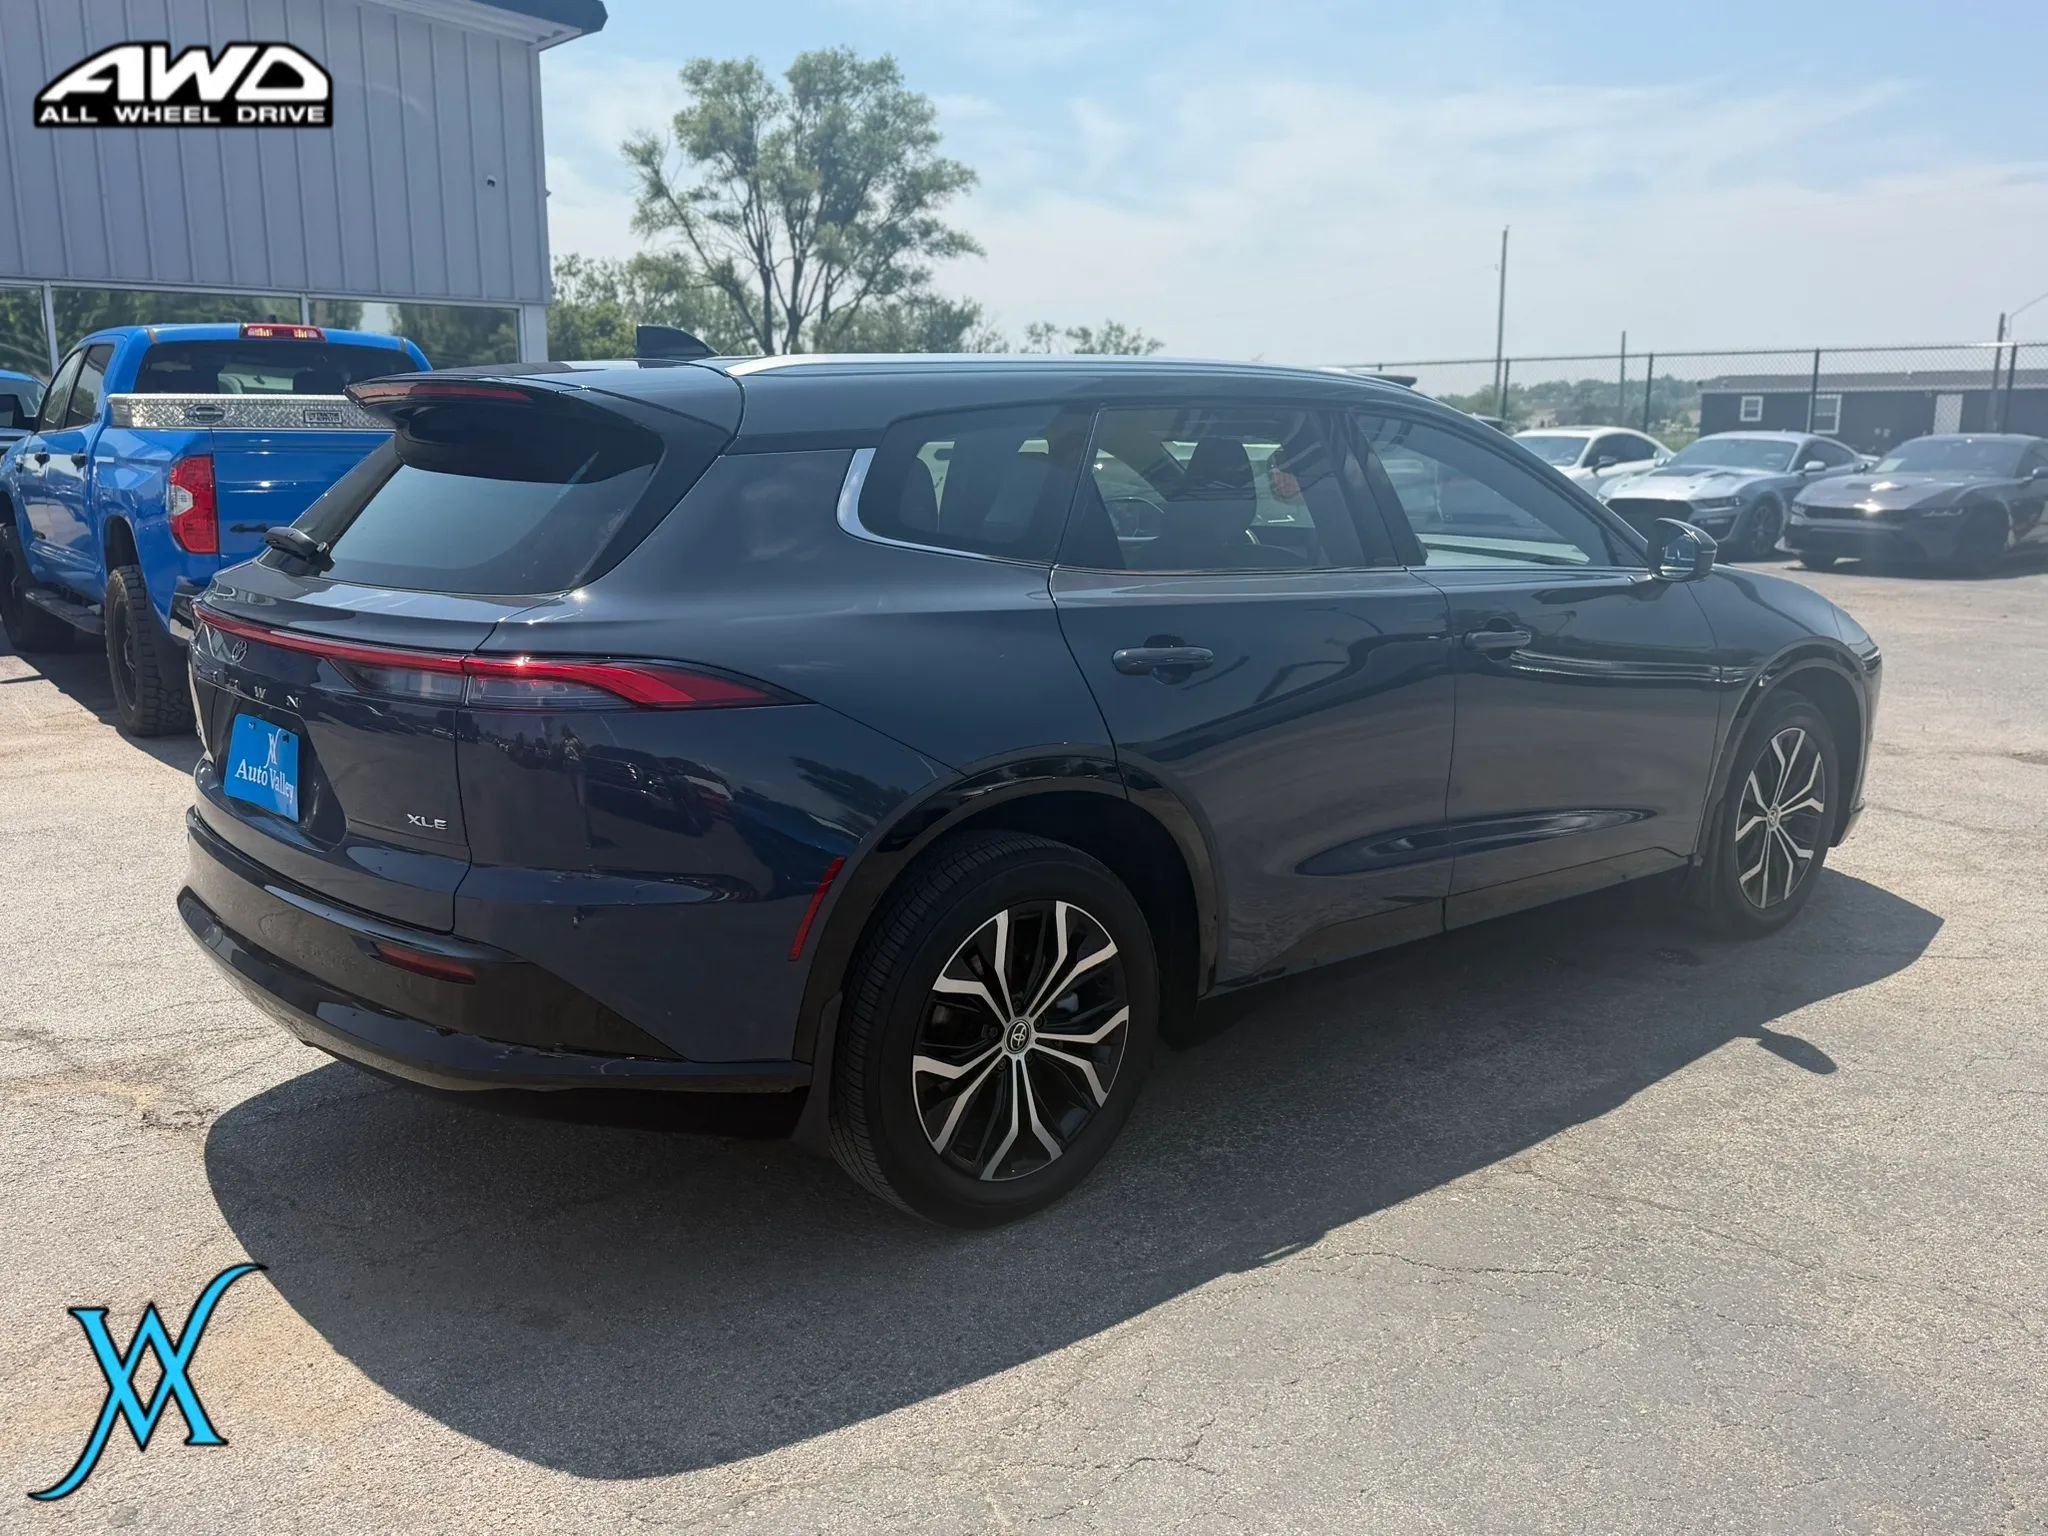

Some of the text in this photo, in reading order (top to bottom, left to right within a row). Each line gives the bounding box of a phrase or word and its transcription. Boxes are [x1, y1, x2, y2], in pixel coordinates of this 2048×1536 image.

[235, 758, 295, 805] Auto Valley
[407, 813, 448, 830] XLE
